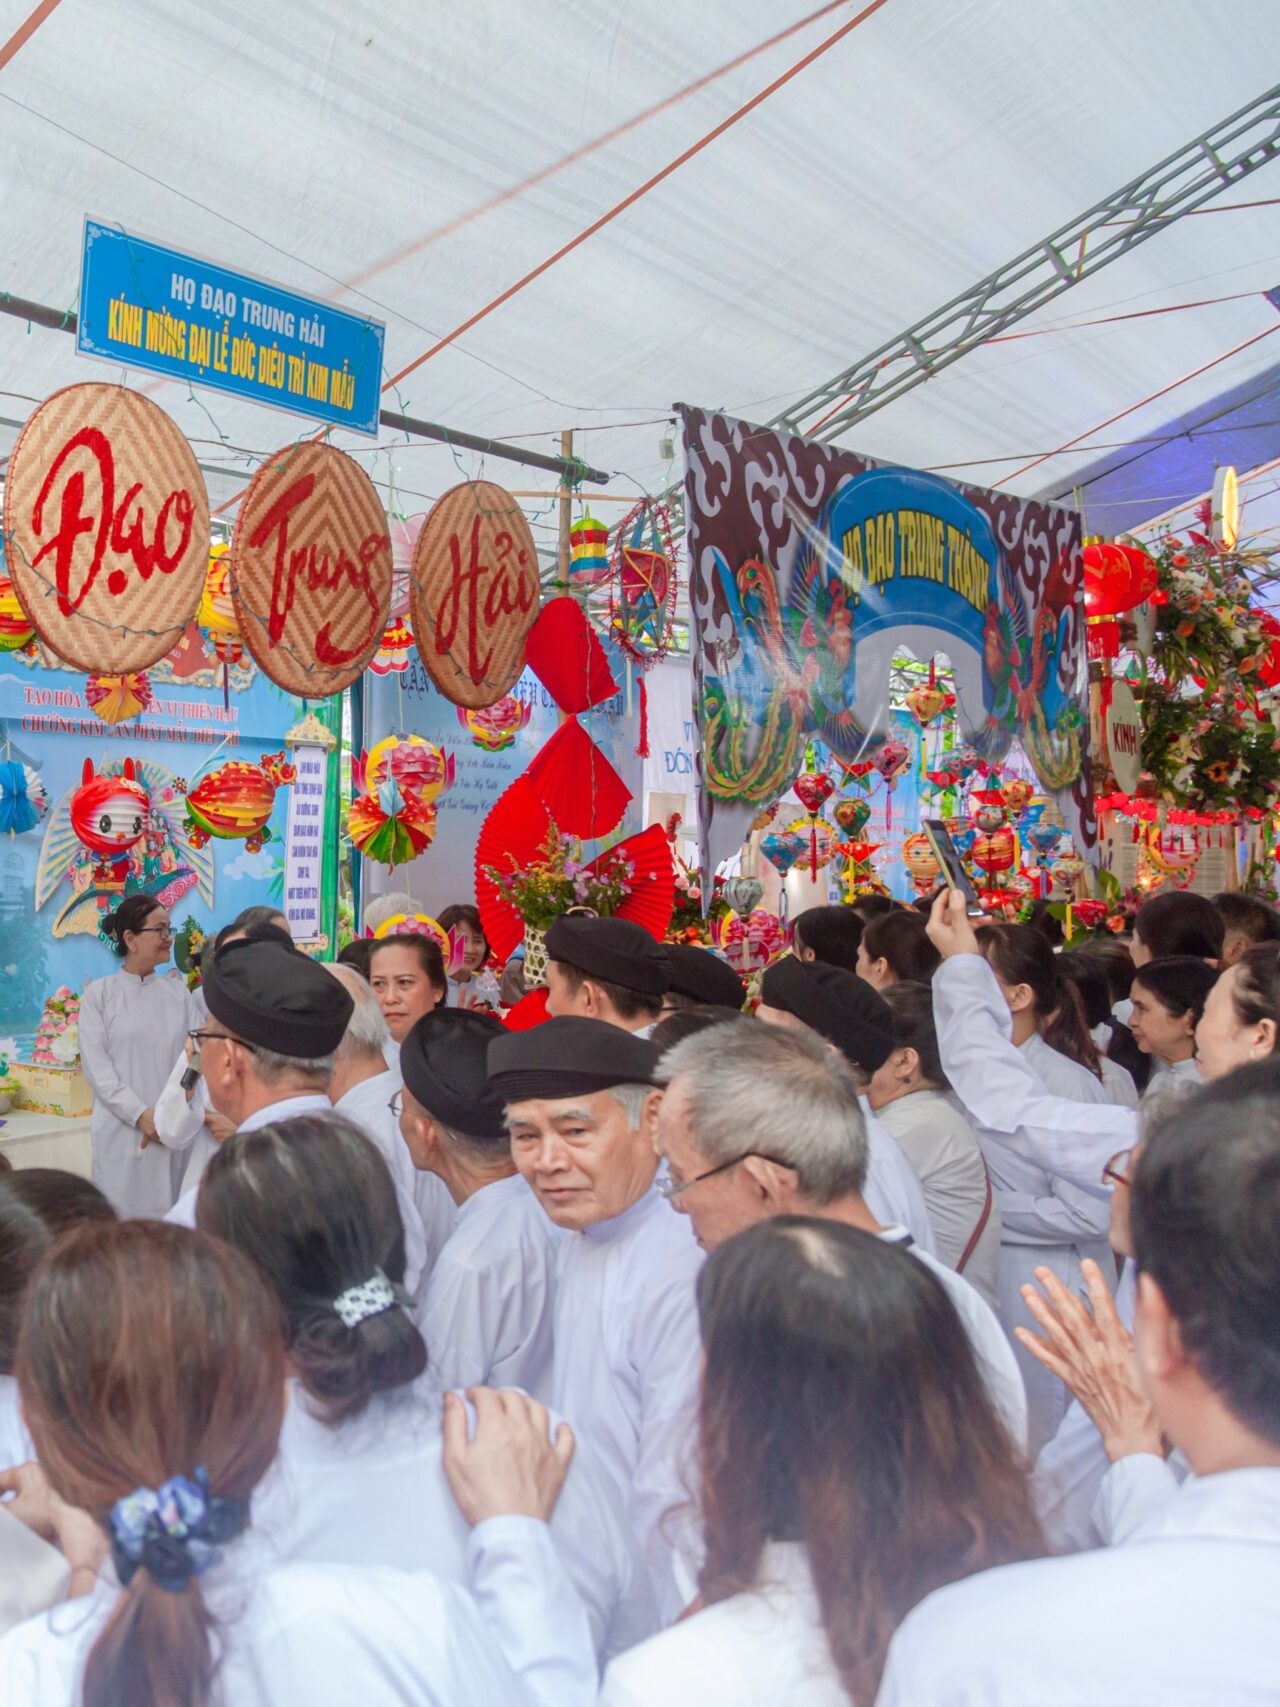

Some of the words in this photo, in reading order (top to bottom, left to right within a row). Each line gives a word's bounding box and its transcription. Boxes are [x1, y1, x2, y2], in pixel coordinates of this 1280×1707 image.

[108, 292, 143, 348] KÍNH
[145, 305, 187, 361] MỪNG
[189, 323, 211, 375] ĐẠI
[213, 319, 229, 373] LỄ
[231, 331, 256, 381] ĐỨC
[288, 350, 306, 396] TRÌ
[307, 361, 329, 403] KIM
[329, 358, 355, 411] MẪU
[171, 273, 196, 310] HỌ
[200, 283, 236, 321] ĐẠO
[242, 297, 295, 338] TRUNG
[299, 313, 326, 348] HẢI
[31, 425, 196, 617] Đạo
[250, 472, 388, 666] Trung
[435, 514, 536, 686] Hải
[841, 522, 864, 608] HỌ
[864, 510, 895, 597] ĐẠO
[896, 508, 945, 585] TRUNG
[946, 522, 990, 614] THÀNH
[24, 687, 52, 709] TẠO
[53, 686, 81, 708] HÓA
[80, 719, 105, 736] KIM
